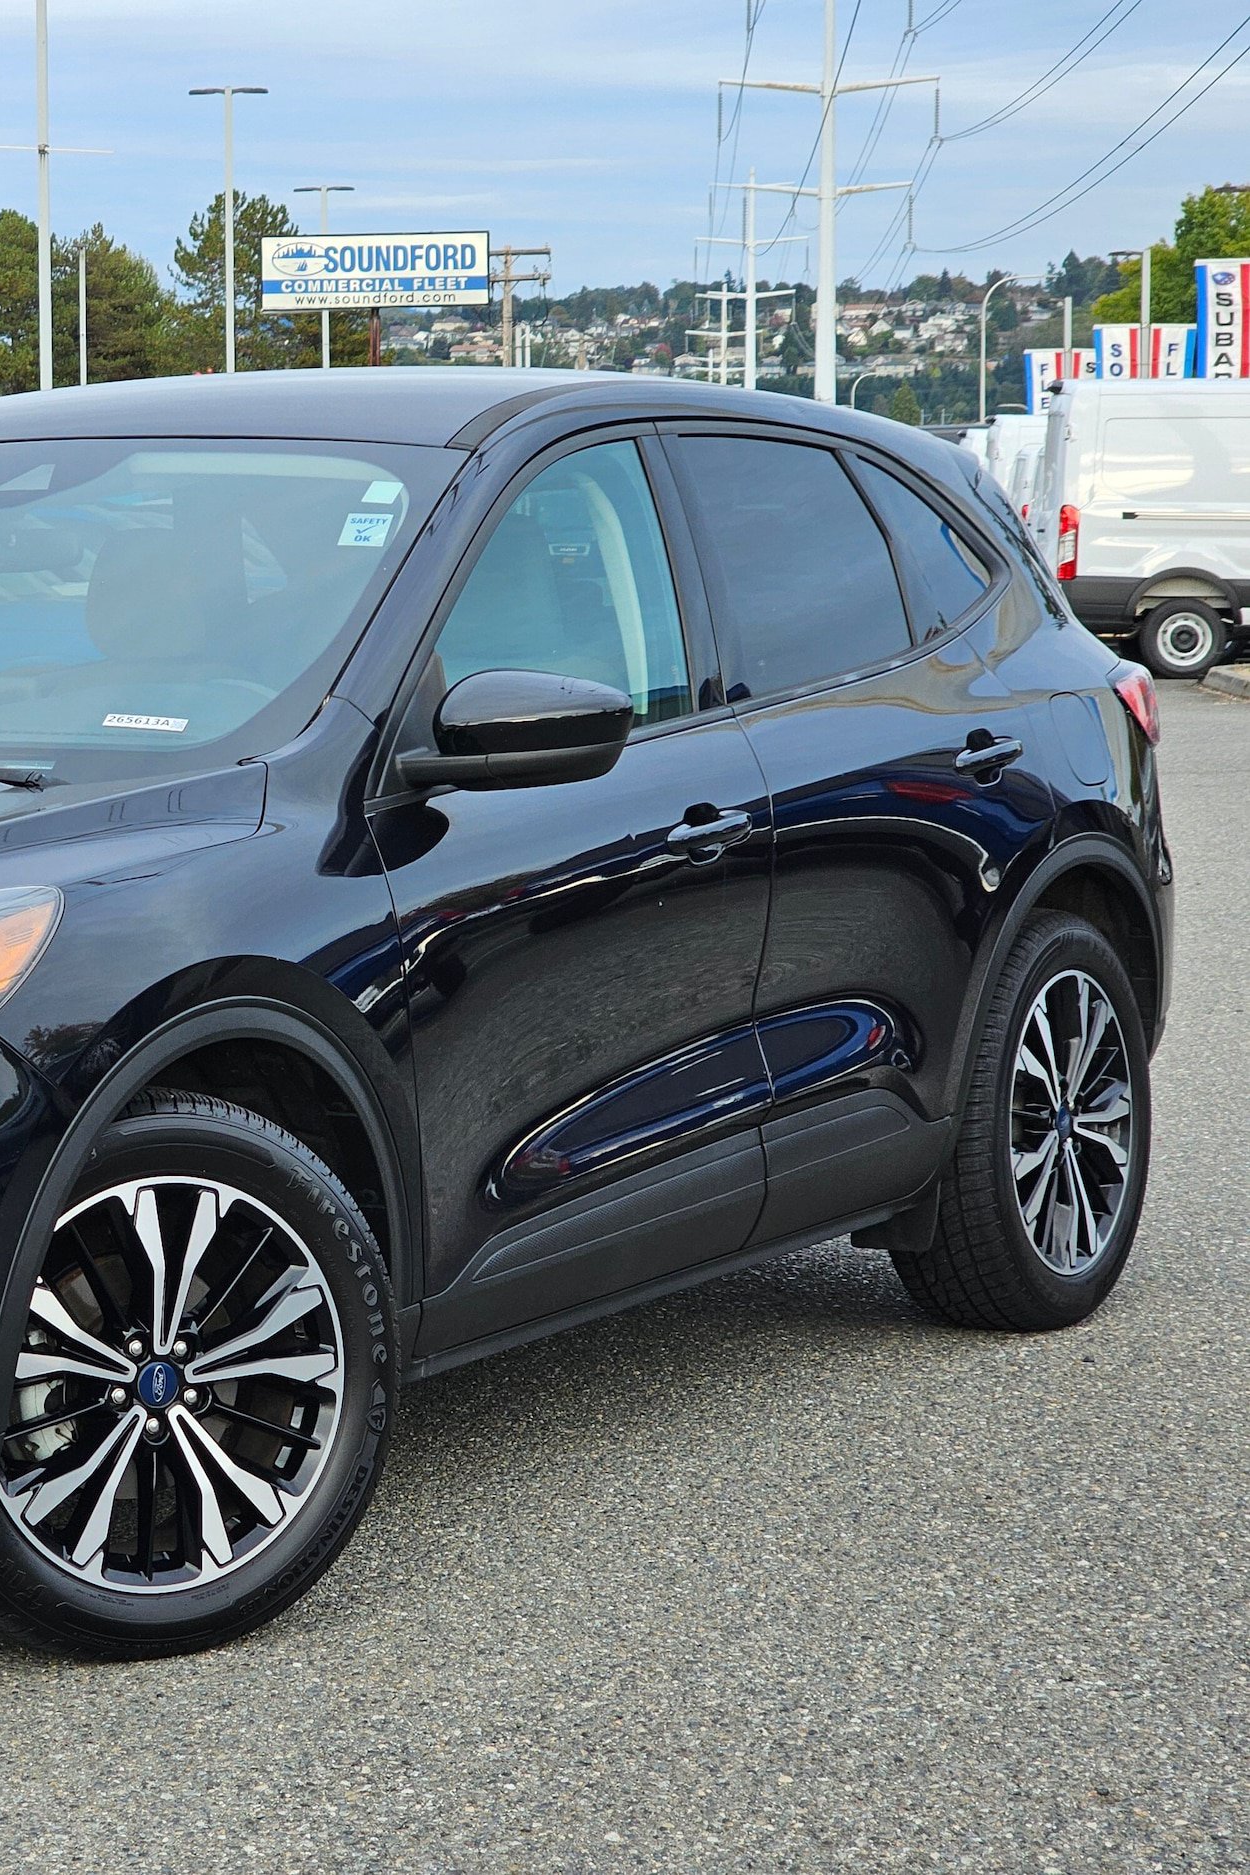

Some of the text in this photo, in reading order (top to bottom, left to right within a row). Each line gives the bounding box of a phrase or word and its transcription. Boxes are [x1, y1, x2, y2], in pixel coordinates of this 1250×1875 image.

[323, 243, 476, 273] SOUNDFORD
[280, 276, 468, 293] COMMERCIAL FLEET
[295, 292, 456, 305] www.soundford.com
[350, 517, 388, 525] SAFETY
[107, 715, 170, 727] 265613A
[286, 1164, 388, 1366] Firestone
[263, 1464, 369, 1597] DESTINATION
